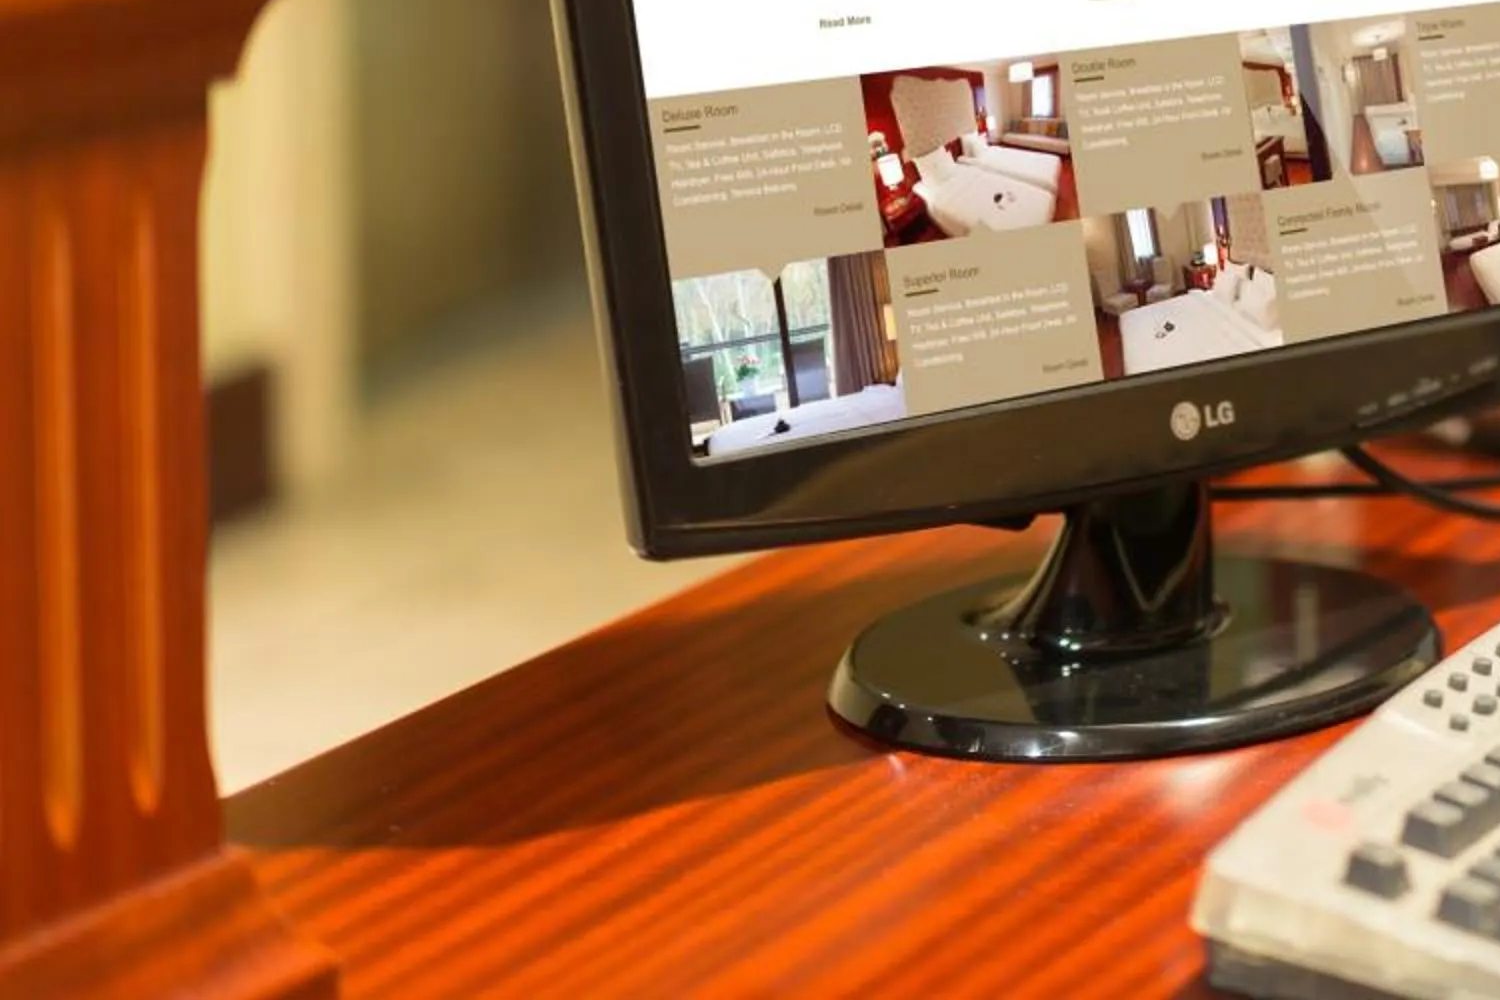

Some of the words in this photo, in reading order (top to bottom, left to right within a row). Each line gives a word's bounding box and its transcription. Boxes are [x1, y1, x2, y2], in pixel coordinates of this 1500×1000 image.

[818, 17, 845, 29] Read
[846, 15, 871, 26] More
[1071, 61, 1106, 74] Double
[1107, 57, 1136, 69] Room
[661, 108, 702, 123] Deluxe
[704, 105, 738, 118] Room
[1204, 400, 1235, 428] LG
